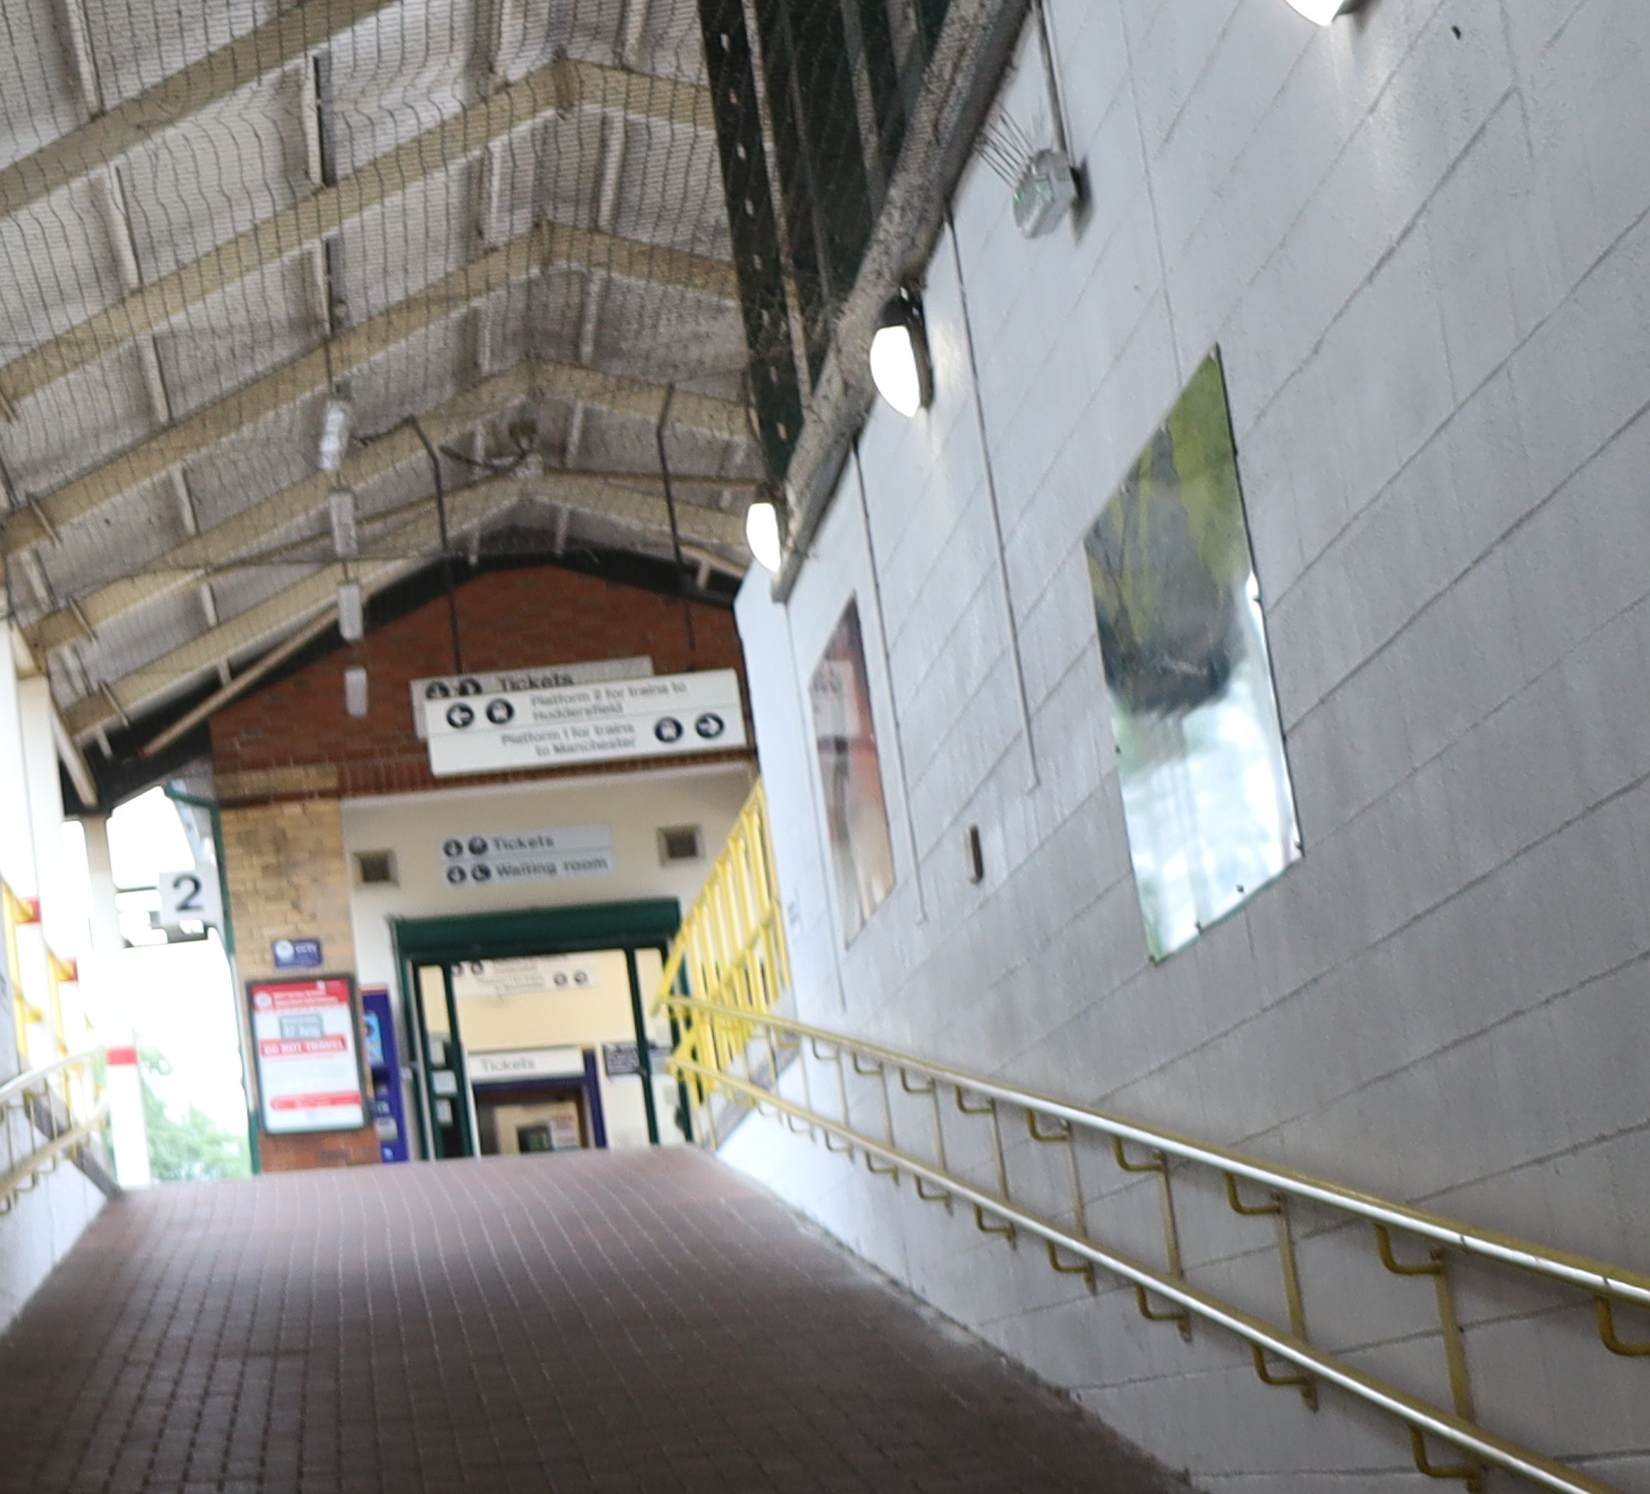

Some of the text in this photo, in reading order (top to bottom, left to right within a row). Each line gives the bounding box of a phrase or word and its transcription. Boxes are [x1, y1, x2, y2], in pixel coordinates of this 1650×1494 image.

[501, 673, 575, 692] Tickets
[531, 691, 591, 706] Platform
[604, 687, 624, 700] for
[627, 682, 669, 697] trains
[672, 681, 687, 693] to
[533, 704, 624, 721] Huddersfield
[502, 729, 561, 746] Platform
[570, 726, 589, 738] for
[593, 723, 635, 736] trains
[535, 737, 636, 756] to Manchester
[493, 835, 555, 851] Tickets
[496, 858, 608, 878] Waiting room
[173, 874, 204, 912] 2
[264, 1037, 344, 1055] DO NOT TRAVEL
[480, 1057, 535, 1072] Tickets
